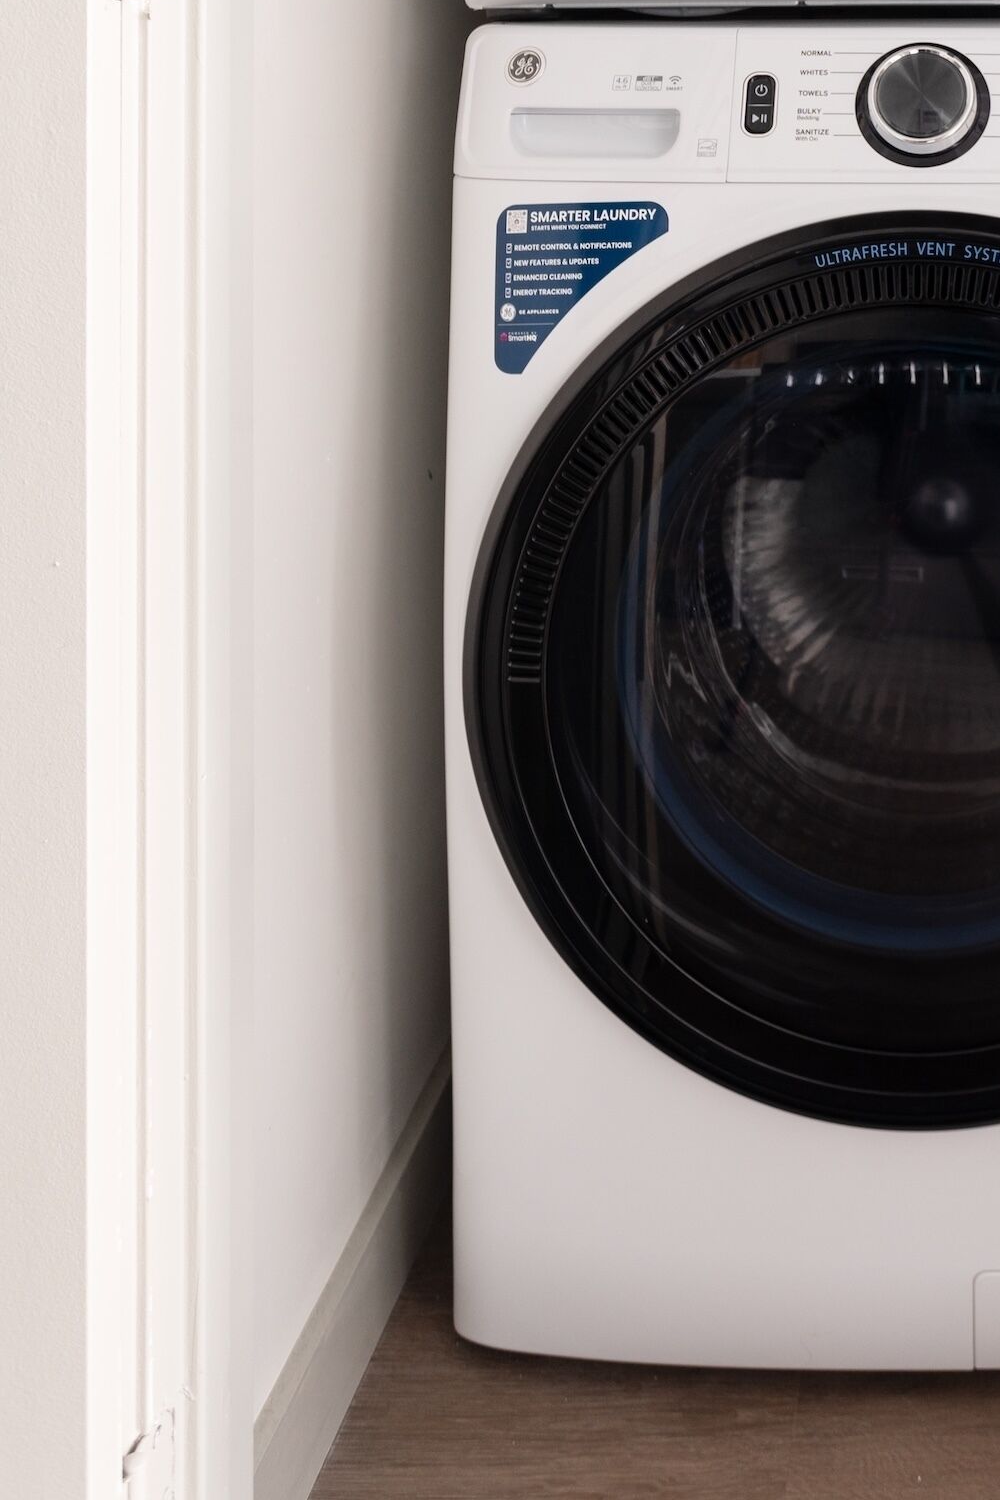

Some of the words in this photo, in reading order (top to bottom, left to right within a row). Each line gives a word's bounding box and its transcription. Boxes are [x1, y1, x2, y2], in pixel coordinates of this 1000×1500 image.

[530, 209, 591, 222] SMARTER
[594, 208, 657, 221] LAUNDRY
[514, 243, 539, 251] REMOTE
[540, 243, 571, 251] CONTROL
[815, 242, 907, 267] ULTRAFRESH
[917, 242, 955, 256] VENT
[513, 288, 537, 296] ENERGY
[538, 287, 573, 295] TRACKING
